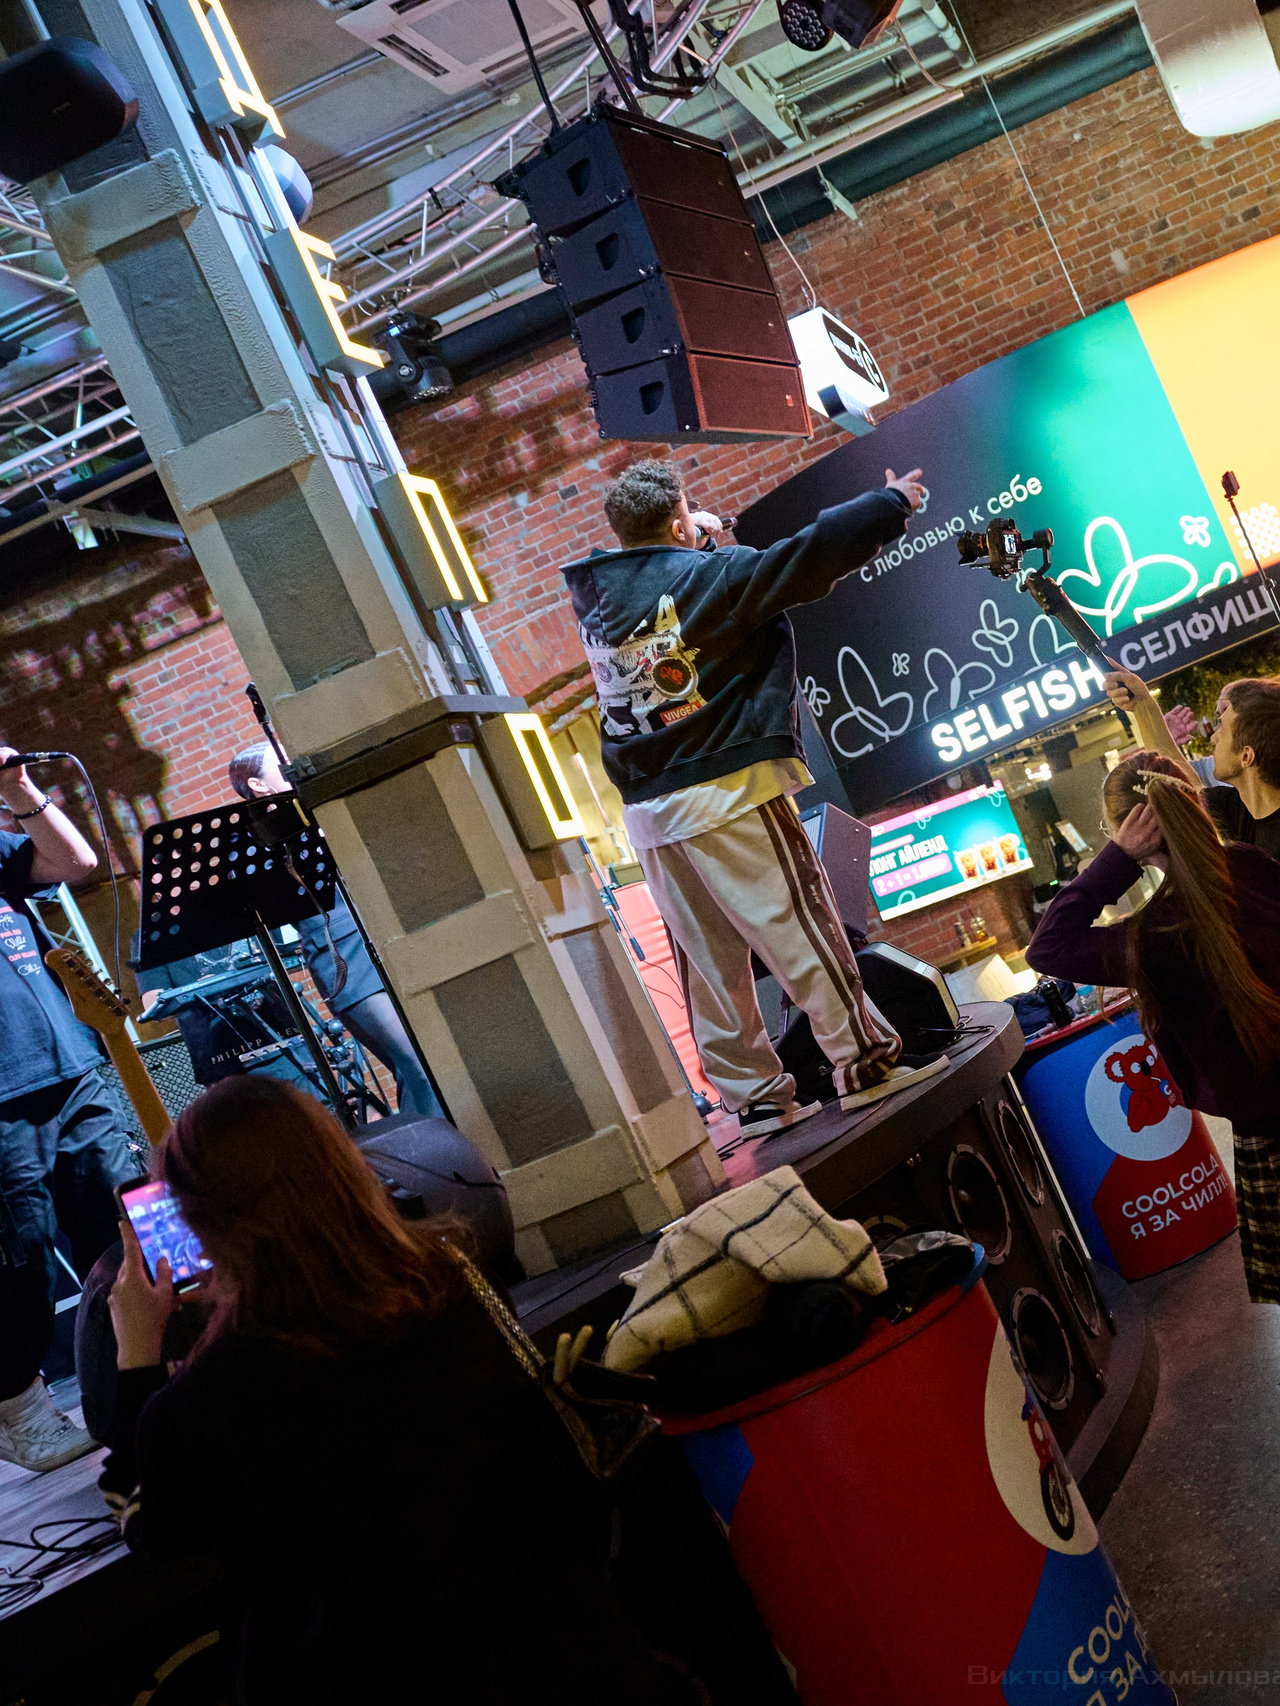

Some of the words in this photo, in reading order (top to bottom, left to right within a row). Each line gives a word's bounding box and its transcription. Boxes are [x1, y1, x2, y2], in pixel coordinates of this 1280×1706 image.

[860, 565, 873, 583] с
[874, 516, 965, 577] любовью
[969, 505, 985, 525] к
[987, 474, 1043, 514] себе
[1119, 584, 1275, 672] СЕЛФИШ
[930, 656, 1107, 763] SELFISH
[869, 852, 897, 877] ЛОНГ
[897, 834, 949, 866] АЙЛЕНД
[876, 879, 887, 893] 2
[895, 872, 904, 886] 1
[211, 1038, 262, 1065] PHILIPP
[1121, 1153, 1220, 1219] COOLCOLA
[1130, 1221, 1147, 1240] Я
[1148, 1208, 1182, 1232] ЗА
[1181, 1172, 1229, 1212] ЧИЛЛ!
[1067, 1594, 1131, 1685] COOL
